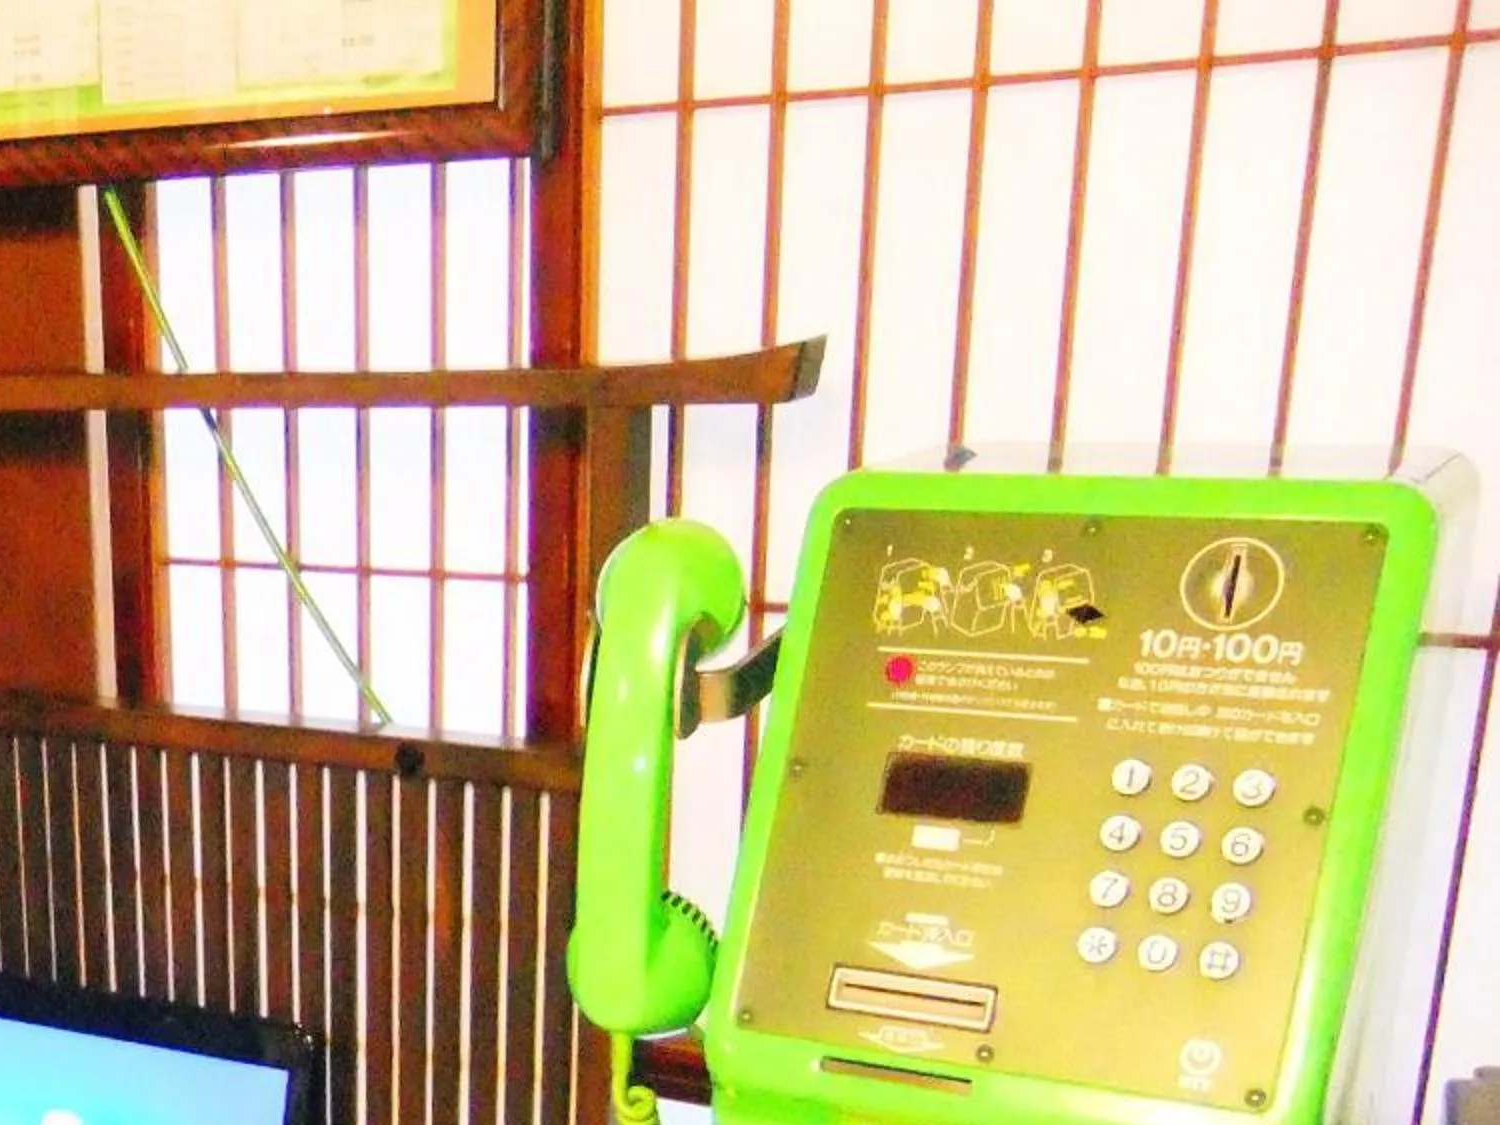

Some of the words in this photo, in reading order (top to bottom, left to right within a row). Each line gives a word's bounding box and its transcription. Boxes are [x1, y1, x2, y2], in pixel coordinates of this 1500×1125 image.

[1138, 629, 1305, 666] 10円・100円
[1180, 769, 1202, 795] 2
[1244, 775, 1264, 801] 3
[1107, 821, 1128, 847] 4
[1169, 827, 1189, 853] 5
[1231, 833, 1251, 859] 6
[1100, 878, 1119, 903] 7
[1157, 883, 1178, 909] 8
[1220, 889, 1241, 915] 9
[1147, 940, 1168, 966] 0
